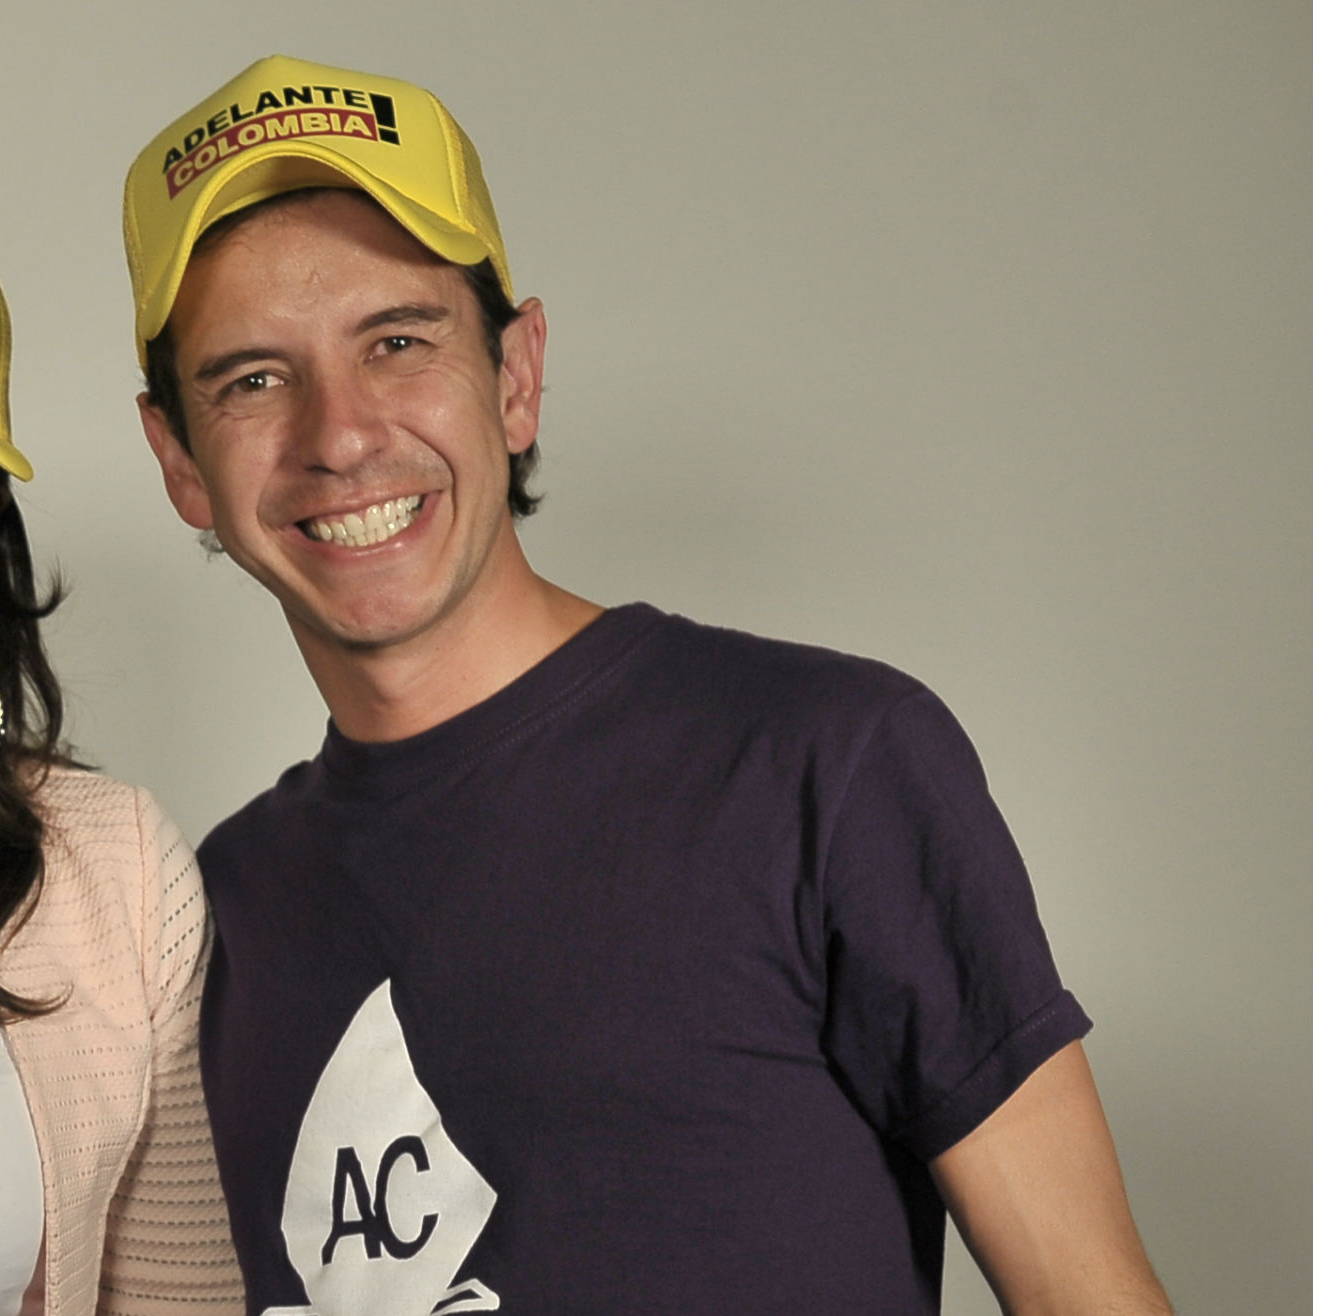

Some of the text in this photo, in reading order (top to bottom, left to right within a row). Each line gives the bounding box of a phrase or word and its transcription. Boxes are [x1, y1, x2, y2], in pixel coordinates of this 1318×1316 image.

[162, 86, 369, 174] ADELANTE
[173, 113, 373, 187] COLOMBIA
[321, 1135, 440, 1267] AC
